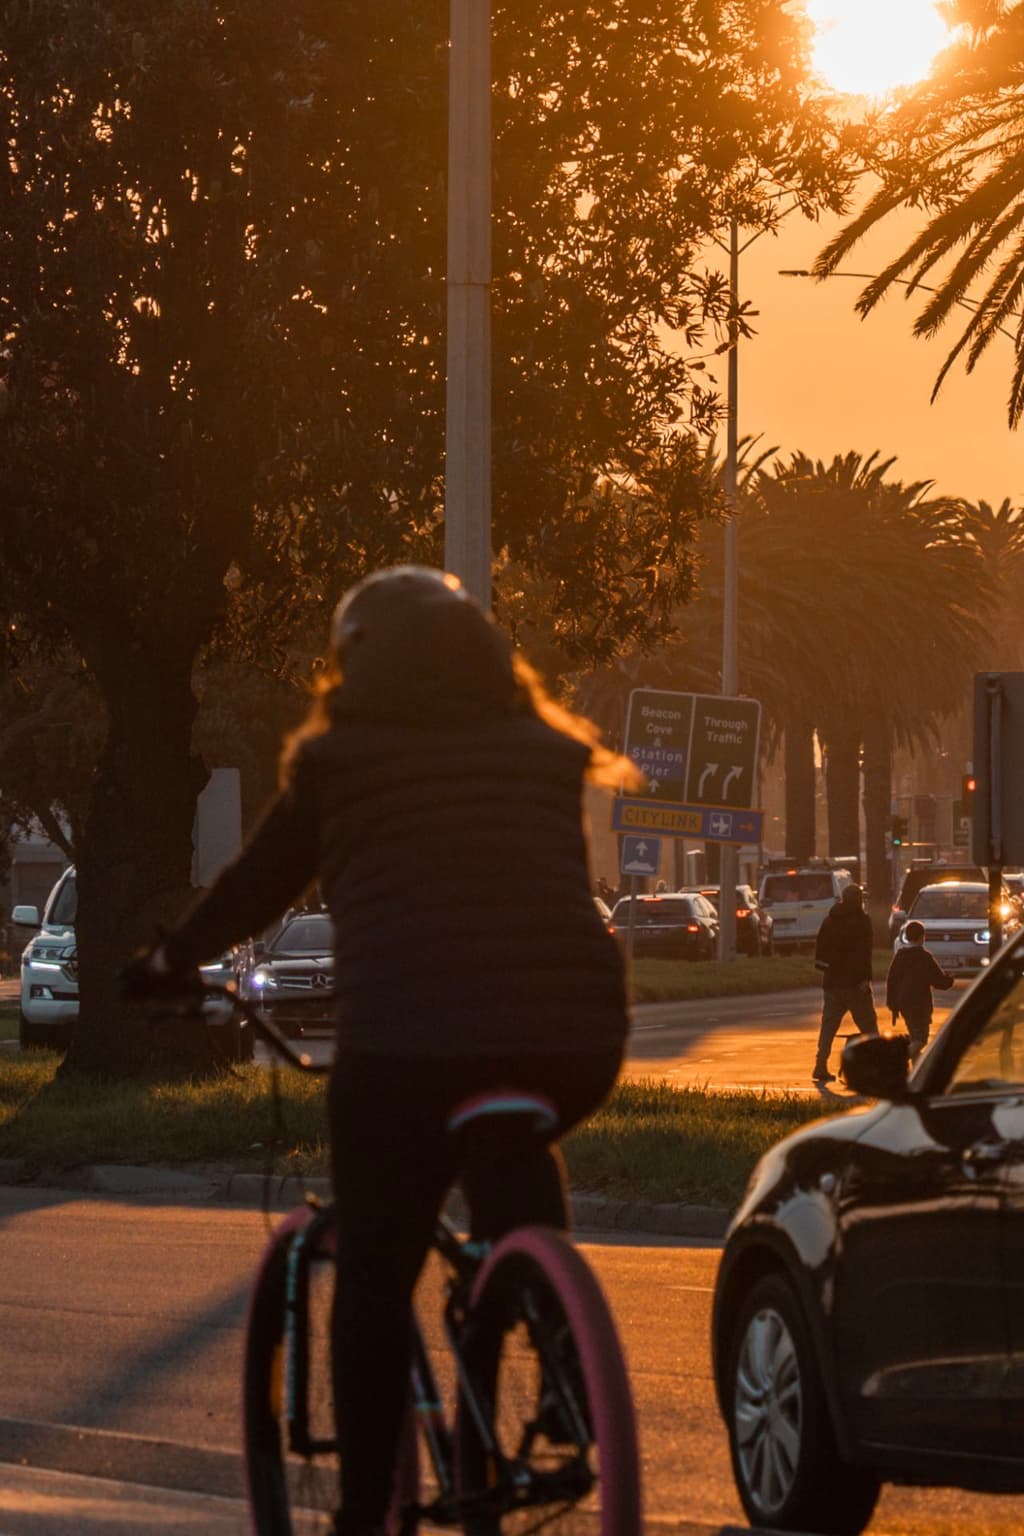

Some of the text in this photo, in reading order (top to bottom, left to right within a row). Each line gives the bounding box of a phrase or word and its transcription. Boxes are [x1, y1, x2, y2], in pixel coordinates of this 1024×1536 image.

[641, 706, 681, 721] Beacon
[646, 723, 673, 735] Cove
[704, 716, 748, 730] Through
[653, 737, 662, 747] &
[706, 731, 743, 745] Traffic
[632, 747, 683, 762] Station
[640, 763, 670, 776] Pier
[624, 808, 697, 828] CITYLINK
